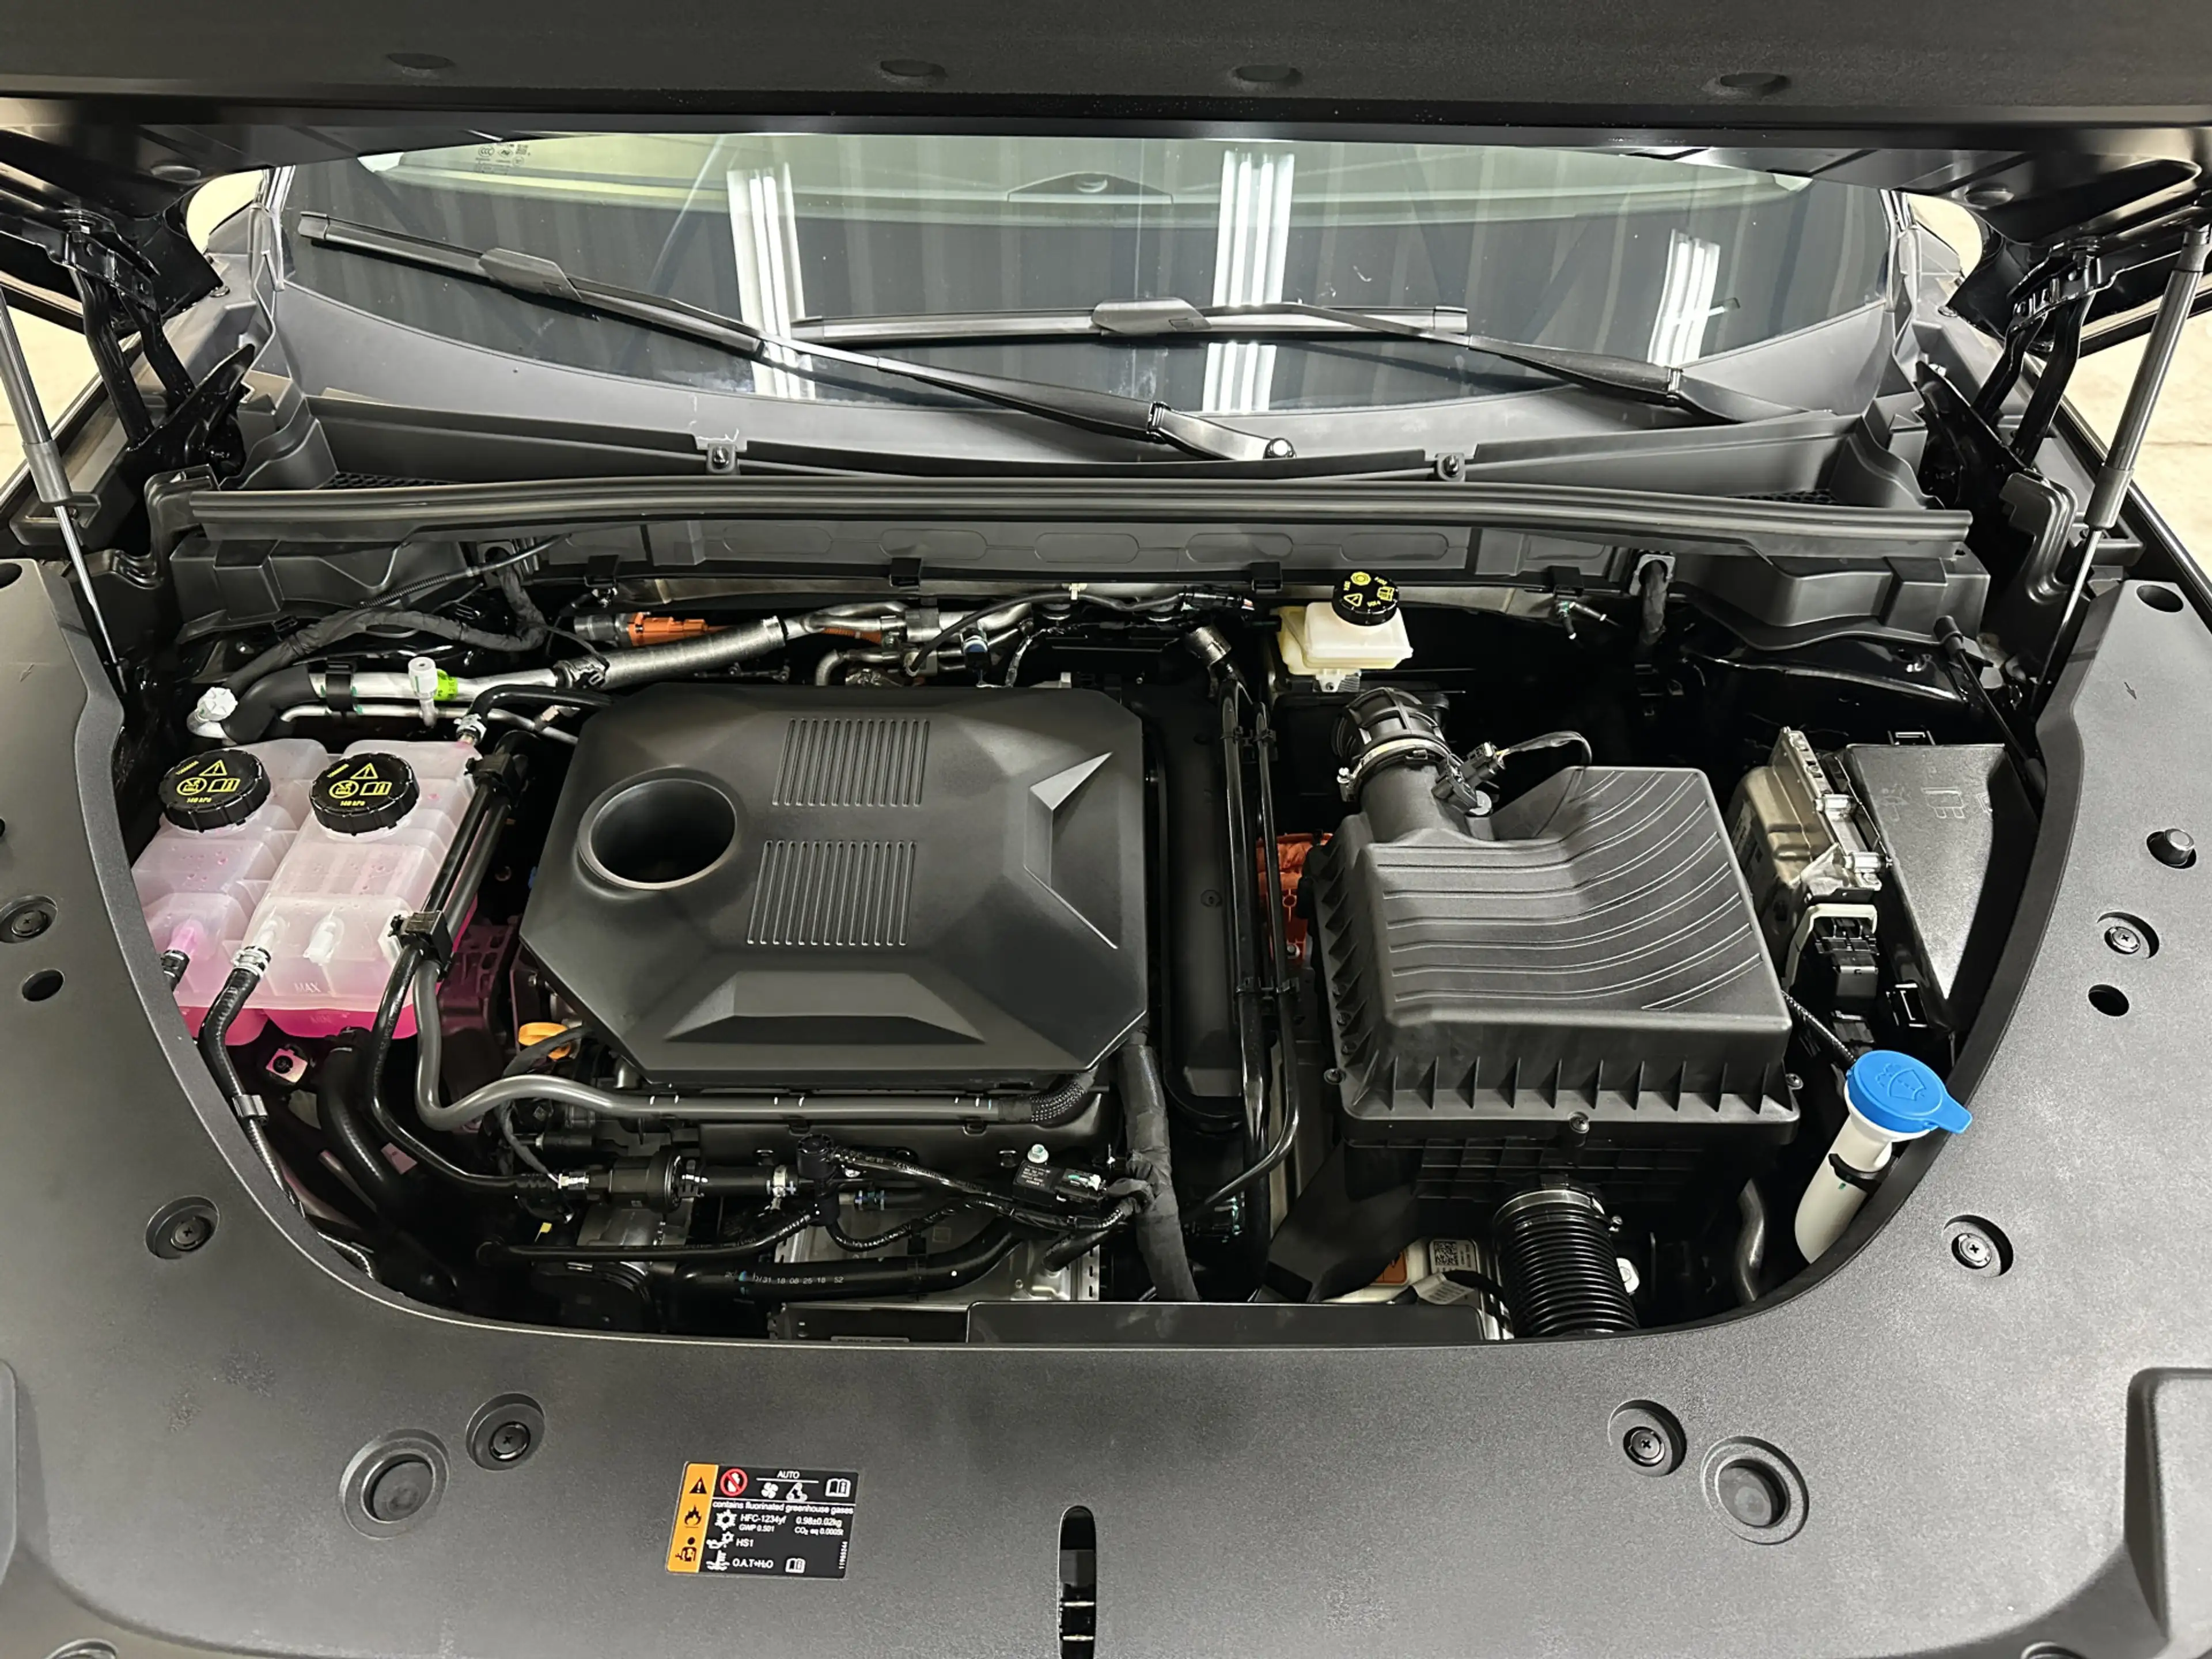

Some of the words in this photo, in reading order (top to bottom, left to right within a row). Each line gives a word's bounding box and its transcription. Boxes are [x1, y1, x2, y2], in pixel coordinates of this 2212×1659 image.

[294, 982, 321, 993] MAX
[777, 1470, 800, 1479] AUTO
[713, 1501, 744, 1509] contains
[745, 1501, 785, 1512] fluorinated
[785, 1504, 830, 1513] greenhouse
[831, 1506, 854, 1516] gases
[740, 1513, 787, 1525] HFC-1234yf
[736, 1538, 754, 1547] HS1
